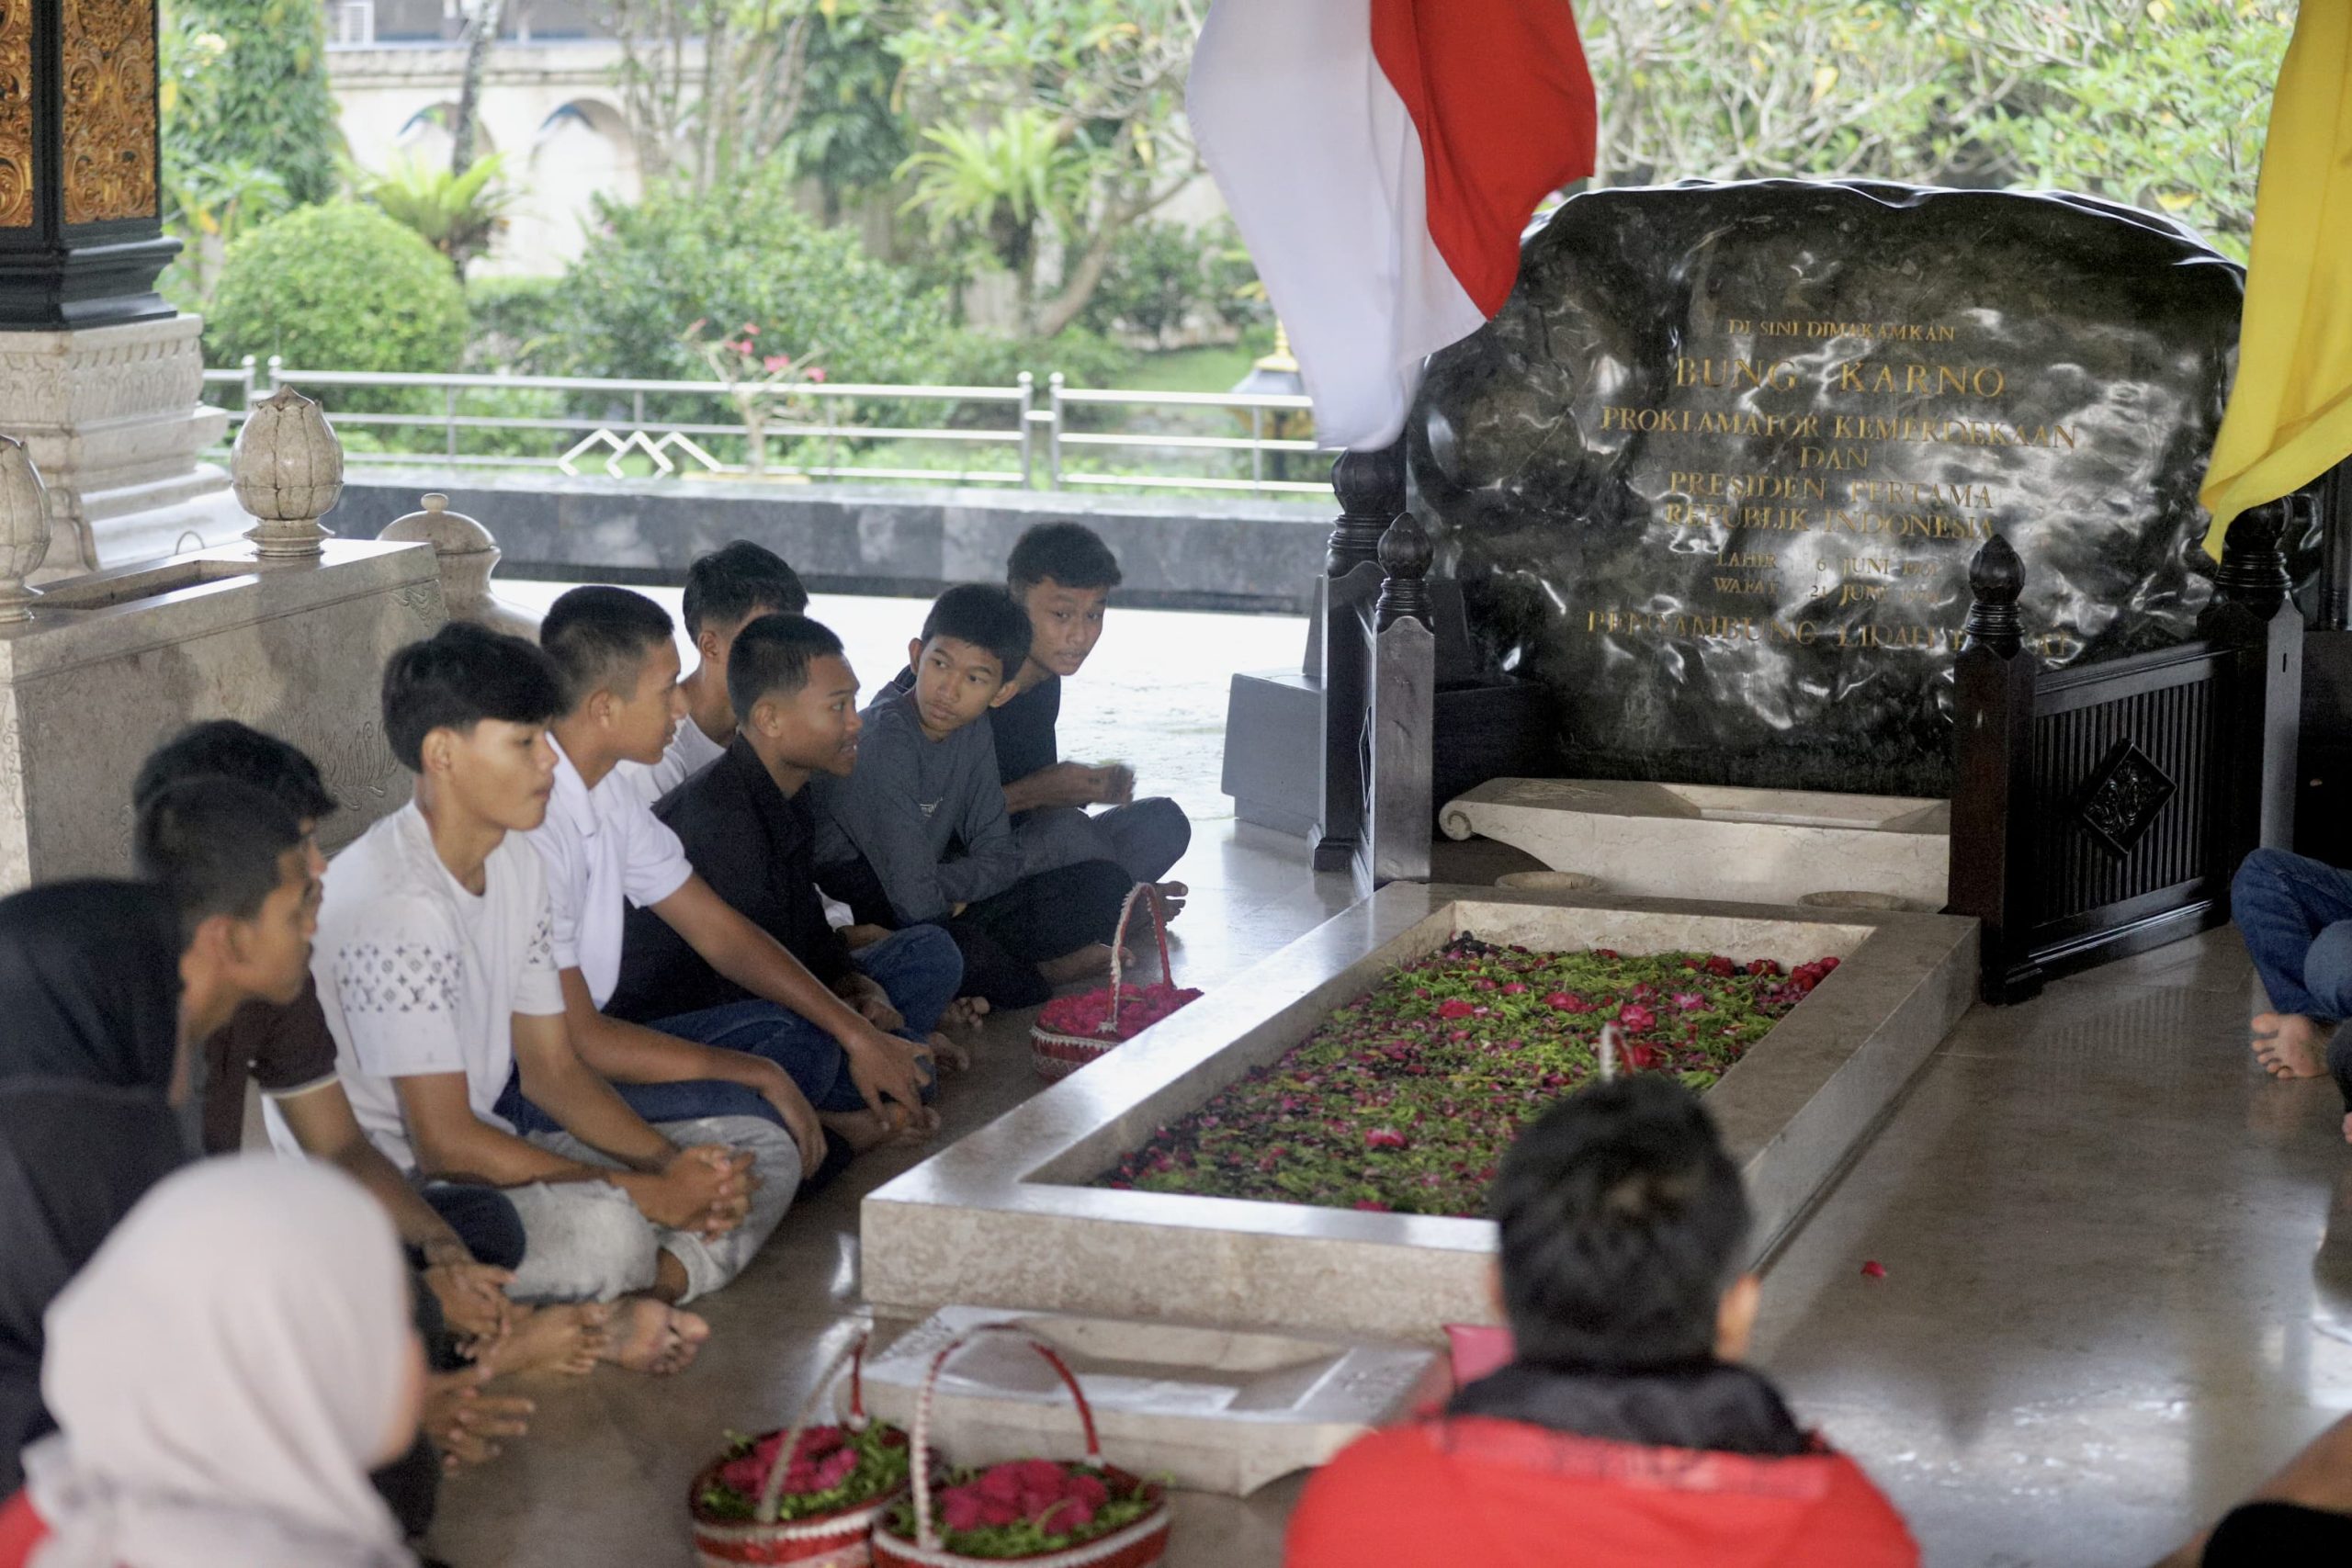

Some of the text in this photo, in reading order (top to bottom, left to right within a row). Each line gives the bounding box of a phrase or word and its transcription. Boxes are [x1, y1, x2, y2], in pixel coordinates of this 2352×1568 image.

[1728, 319, 1955, 343] DI SINI DIMAKAMKAN
[1675, 356, 2006, 398] BUNG KARNO
[1600, 405, 2077, 449] PROKLAMATOR KEMERDEKAAN
[1800, 446, 1869, 471] DAN
[1669, 469, 1993, 509] PRESIDEN PERTAMA
[1664, 502, 1994, 541] REPUBLIK INDONESIA
[1715, 550, 1778, 569] LAHIR
[1841, 557, 1890, 577] JUNI
[1587, 610, 1818, 645] PENYAMBUNG
